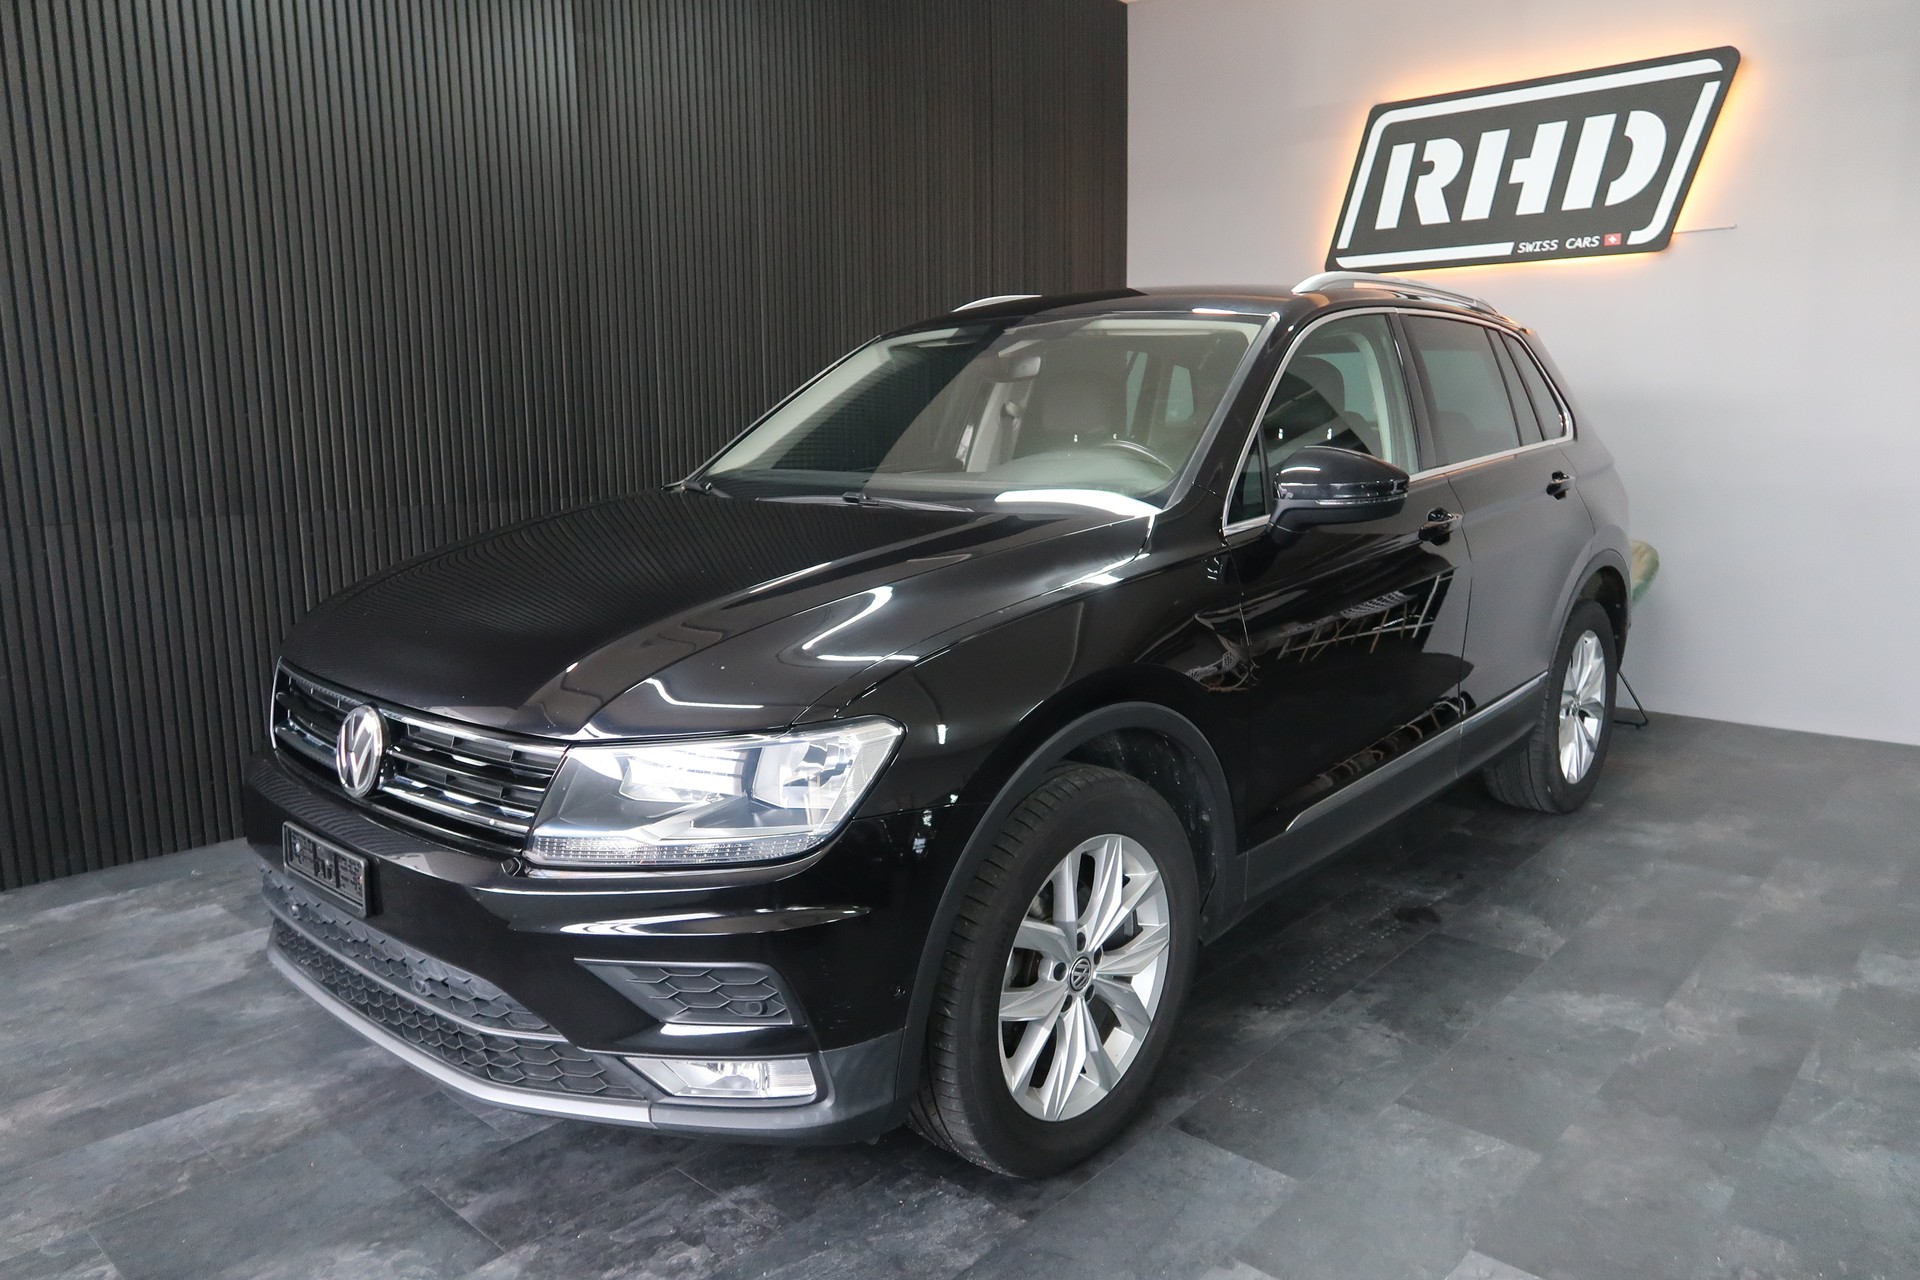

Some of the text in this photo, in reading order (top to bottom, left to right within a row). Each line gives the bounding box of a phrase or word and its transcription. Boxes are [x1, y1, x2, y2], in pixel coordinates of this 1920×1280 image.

[1375, 110, 1667, 230] RHD
[1517, 235, 1600, 254] SWISS CARS
